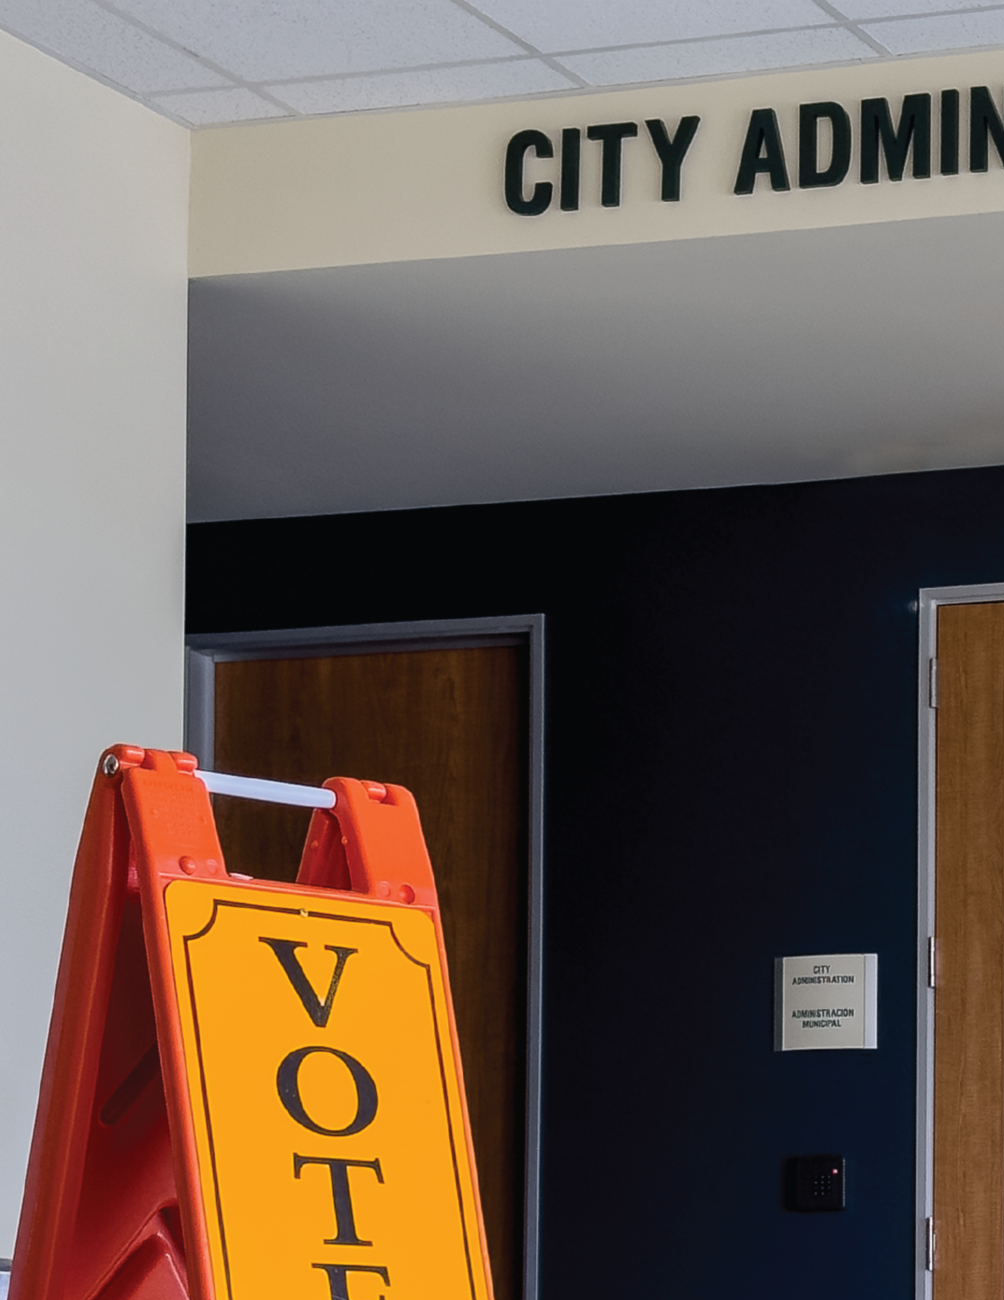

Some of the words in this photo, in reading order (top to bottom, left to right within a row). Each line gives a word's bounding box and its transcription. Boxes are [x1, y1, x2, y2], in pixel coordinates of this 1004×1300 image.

[503, 114, 701, 218] CITY
[813, 965, 831, 975] CITY
[791, 975, 855, 986] ADMINISTRATION
[802, 1019, 842, 1029] MUNICIPAL
